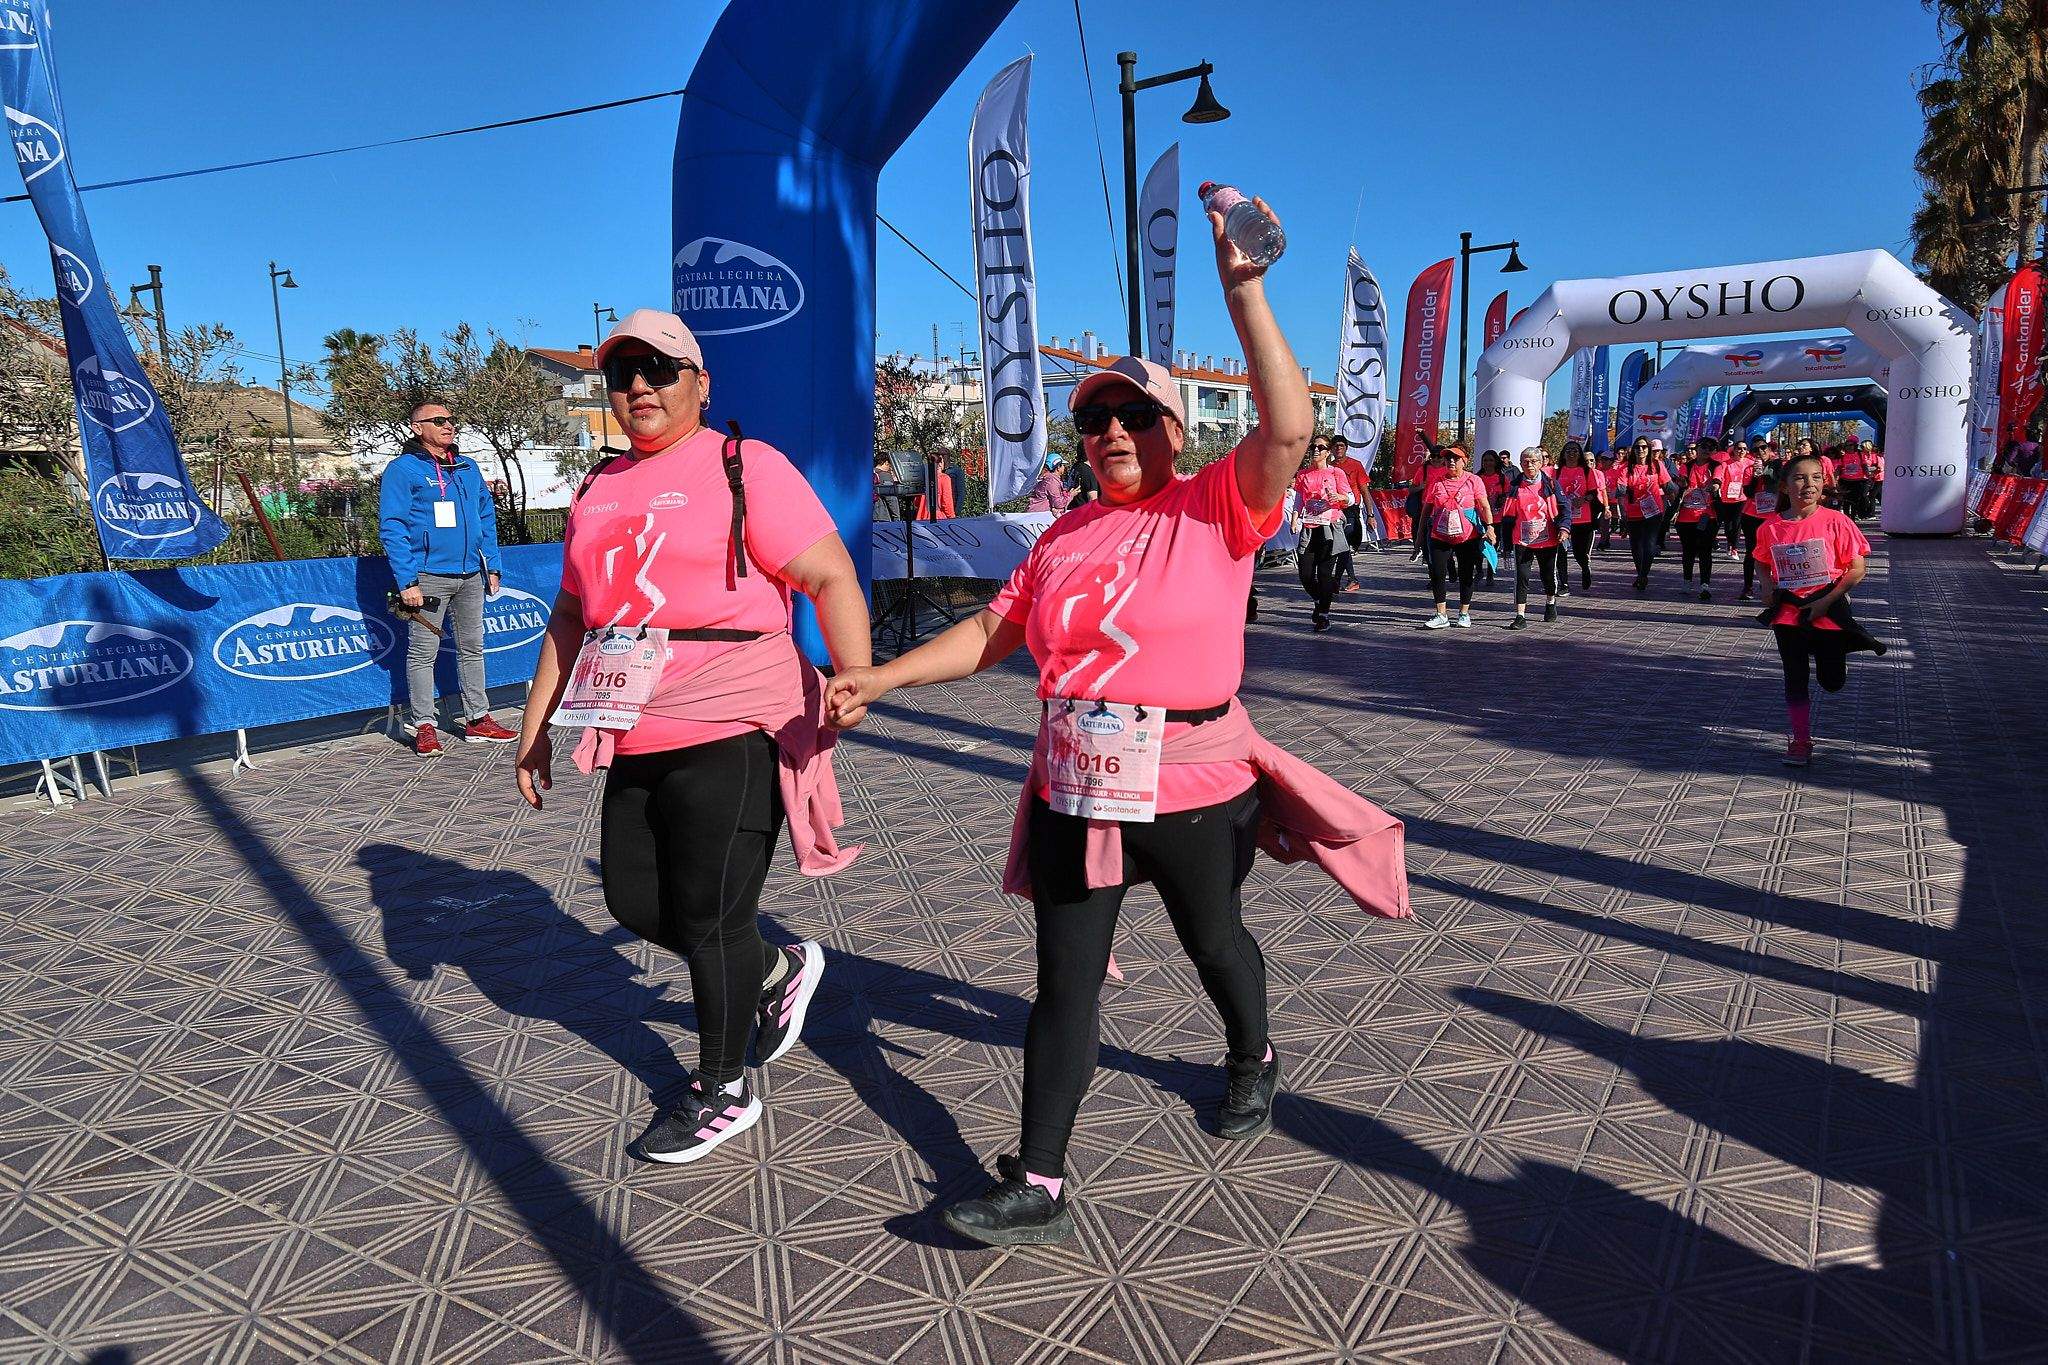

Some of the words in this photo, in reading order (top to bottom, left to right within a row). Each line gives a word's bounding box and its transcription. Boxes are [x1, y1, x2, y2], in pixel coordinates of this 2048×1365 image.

[677, 271, 715, 285] CENTRAL
[719, 270, 783, 281] LECHERA
[673, 285, 789, 313] STURIANA
[980, 149, 1034, 443] OYSHO
[1608, 275, 1805, 325] OYSHO
[1866, 305, 1933, 322] OYSHO
[1415, 289, 1438, 381] Santander
[2016, 288, 2032, 373] Santander
[1503, 336, 1554, 350] OYSHO
[1339, 276, 1383, 449] OYSHO
[1769, 394, 1854, 406] VOLVO
[1899, 385, 1962, 400] OYSHO
[1478, 407, 1524, 418] OYSHO
[1407, 410, 1428, 465] Spots
[1894, 464, 1956, 477] OYSHO
[149, 491, 184, 499] LECHER
[105, 493, 191, 520] ASTURIAN
[583, 501, 618, 516] OYSHO
[1790, 562, 1810, 571] 016
[494, 602, 536, 613] LECHERA
[256, 625, 309, 641] CENTRAL
[319, 622, 374, 635] LECHERA
[12, 650, 89, 666] CENTRAL
[97, 643, 166, 656] LECHERA
[232, 632, 386, 667] ASTURIANA
[592, 672, 627, 688] 016
[607, 715, 637, 724] Santande
[1080, 717, 1120, 730] ASTURIANA
[1077, 753, 1120, 774] 016
[1084, 777, 1103, 787] 7096
[1113, 791, 1141, 801] VALENCIA
[1103, 805, 1141, 814] Santander
